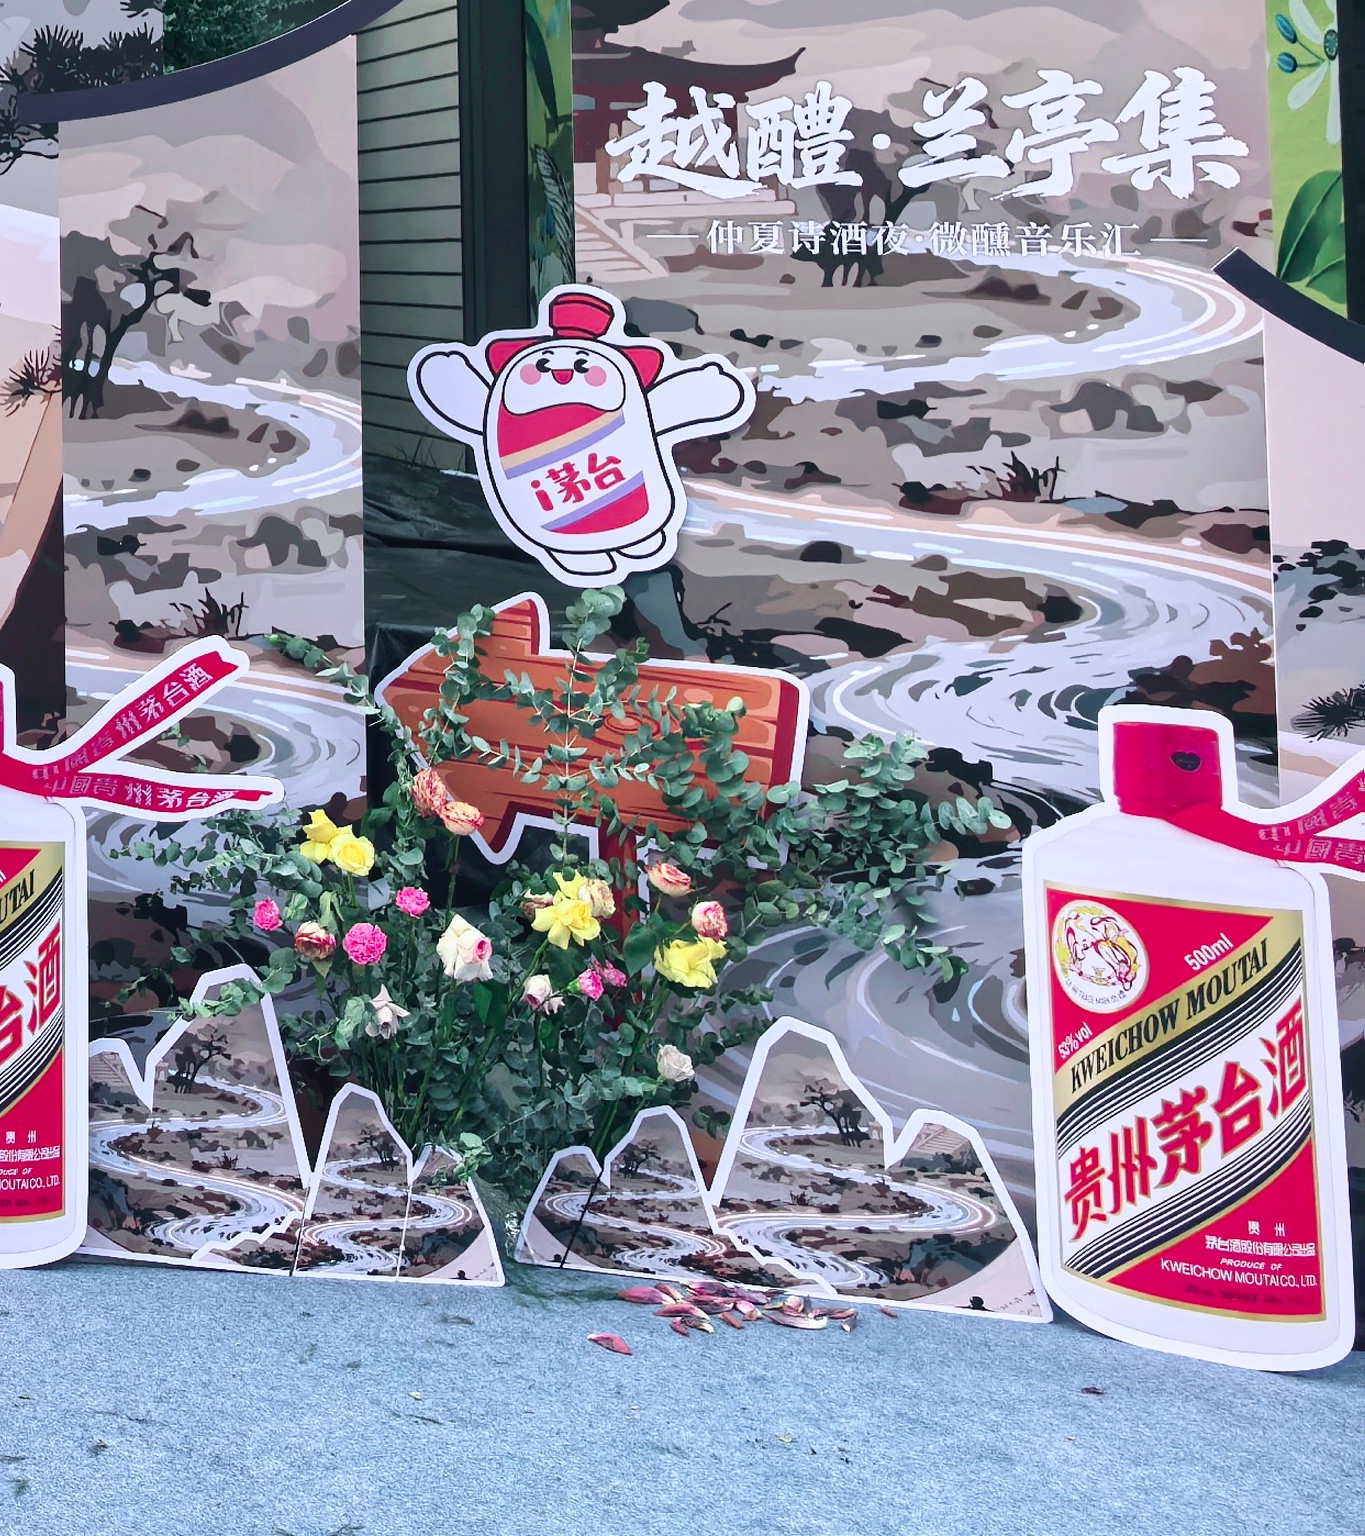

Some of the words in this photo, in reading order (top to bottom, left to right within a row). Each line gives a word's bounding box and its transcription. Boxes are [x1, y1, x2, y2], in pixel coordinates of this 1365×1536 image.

[706, 219, 1142, 259] 仲夏诗酒夜·微醺音乐汇
[530, 452, 627, 511] i茅台
[1183, 933, 1234, 972] 500ml
[1071, 998, 1180, 1094] KWEICHOW
[1186, 937, 1268, 1021] MOUTAI
[1064, 996, 1308, 1244] 贵州茅台酒
[21, 1167, 34, 1175] OF
[1160, 1258, 1233, 1283] KWEICHOW
[1234, 1271, 1280, 1287] MOUTAI
[1220, 1257, 1266, 1271] PRODUCE
